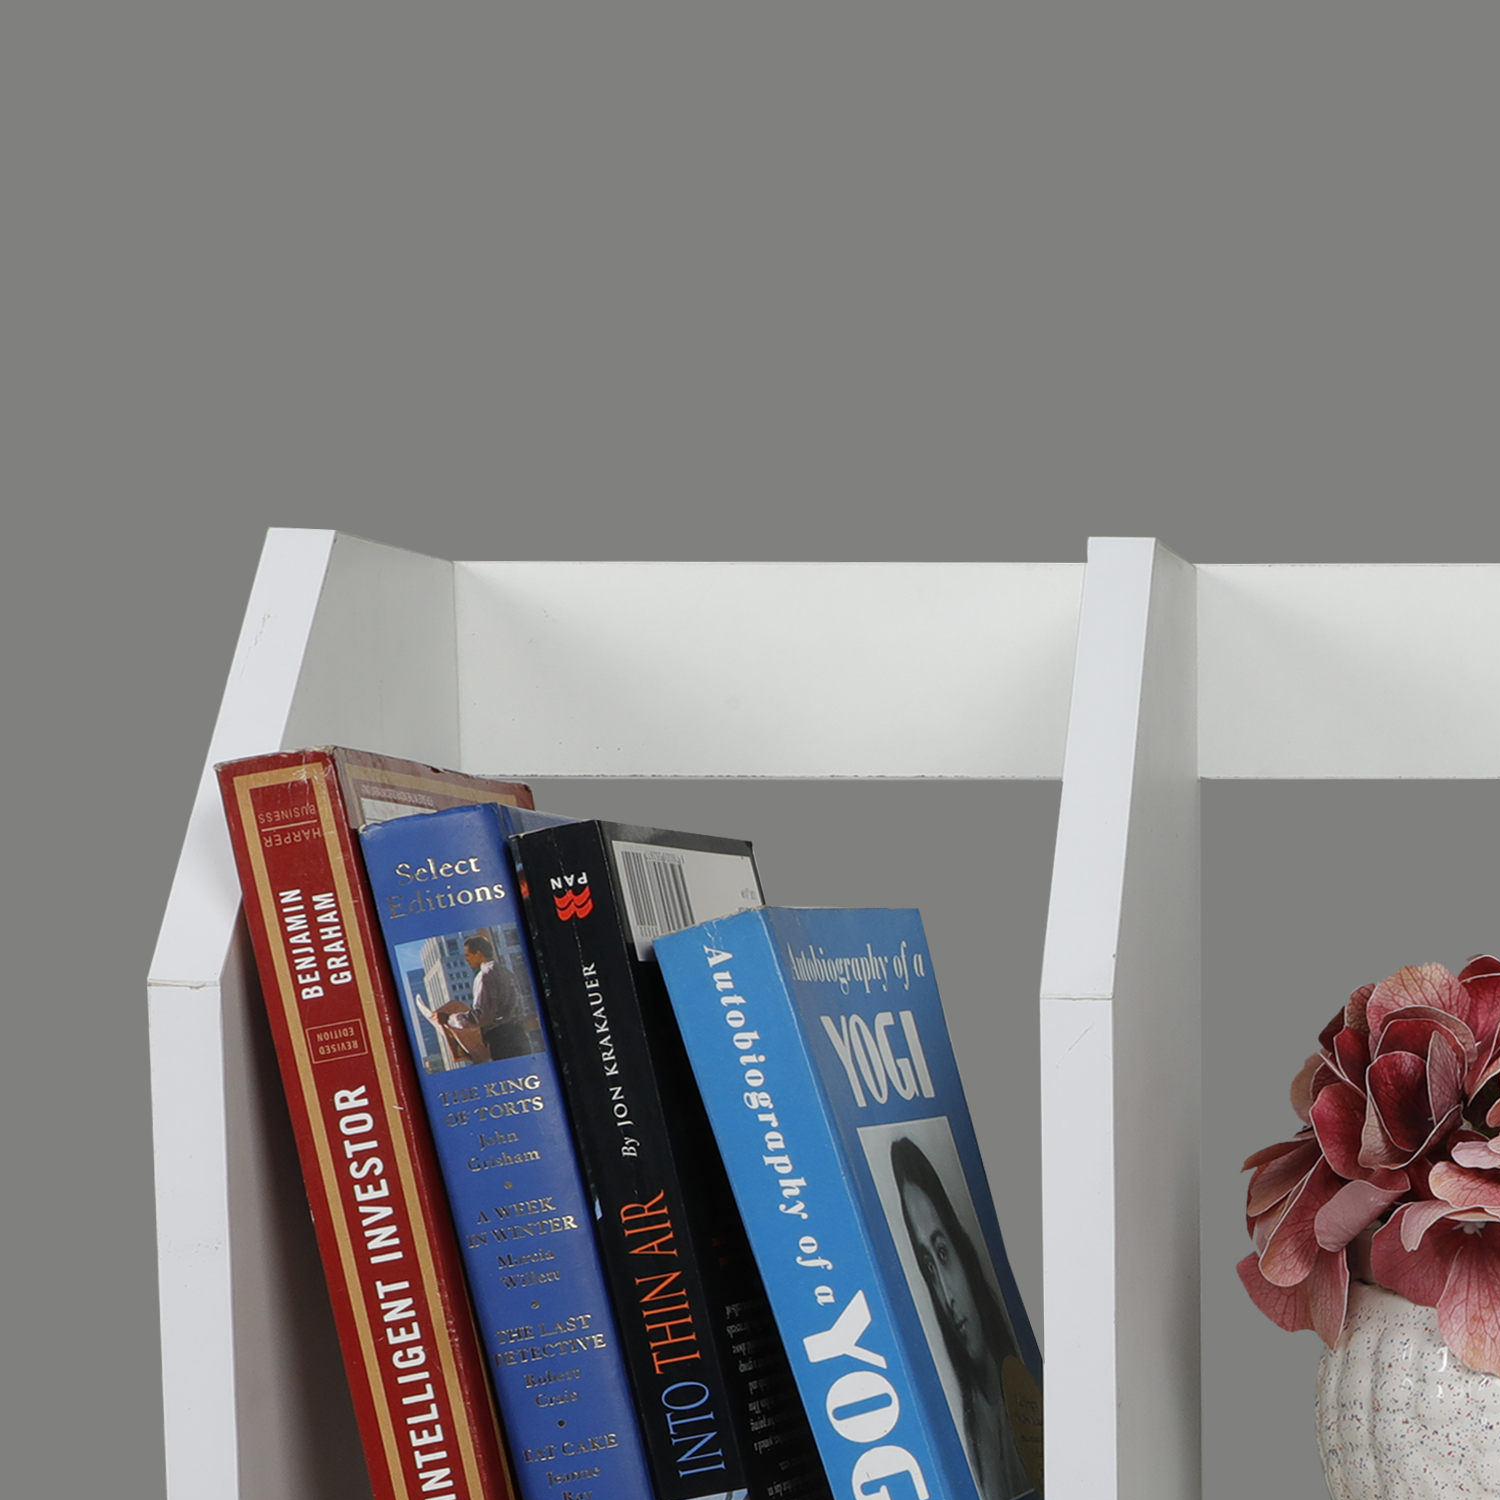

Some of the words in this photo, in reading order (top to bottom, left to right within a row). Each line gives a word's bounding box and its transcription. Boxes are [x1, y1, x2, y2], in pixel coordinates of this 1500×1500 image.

[258, 804, 316, 824] BUSINESS
[263, 828, 321, 848] HARPER
[395, 857, 481, 885] Select
[550, 872, 588, 890] PAN
[387, 883, 506, 919] Editions
[279, 889, 324, 1000] BENJAMIN
[312, 892, 352, 985] GRAHAM
[786, 942, 889, 995] Autobiography
[893, 940, 910, 991] of
[913, 953, 926, 977] a
[316, 1027, 354, 1042] EDITION
[582, 962, 619, 1077] KRAKAUER
[319, 1041, 358, 1056] REVISED
[820, 1010, 936, 1108] YOGI
[437, 1086, 482, 1107] THE
[484, 1075, 541, 1098] KING
[704, 943, 809, 1220] Autobiography
[445, 1109, 471, 1128] OF
[474, 1096, 545, 1122] TORTS
[609, 1085, 635, 1127] JON
[478, 1131, 519, 1151] John
[620, 1137, 640, 1158] By
[334, 1085, 403, 1264] INVESTOR
[467, 1149, 541, 1173] Grisham
[476, 1210, 491, 1226] A
[494, 1196, 557, 1222] WEEK
[620, 1189, 678, 1257] AIR
[466, 1233, 488, 1249] IN
[492, 1215, 578, 1244] WINTER
[497, 1248, 556, 1270] Marcia
[796, 1236, 834, 1274] of
[814, 1285, 836, 1307] a
[494, 1325, 536, 1345] THE
[540, 1313, 592, 1337] LAST
[634, 1271, 701, 1375] THIN
[494, 1333, 608, 1367] DETECTIVE
[524, 1369, 582, 1389] Robert
[661, 1381, 726, 1478] INTO
[523, 1444, 557, 1463] EAT
[561, 1432, 620, 1456] CAKE
